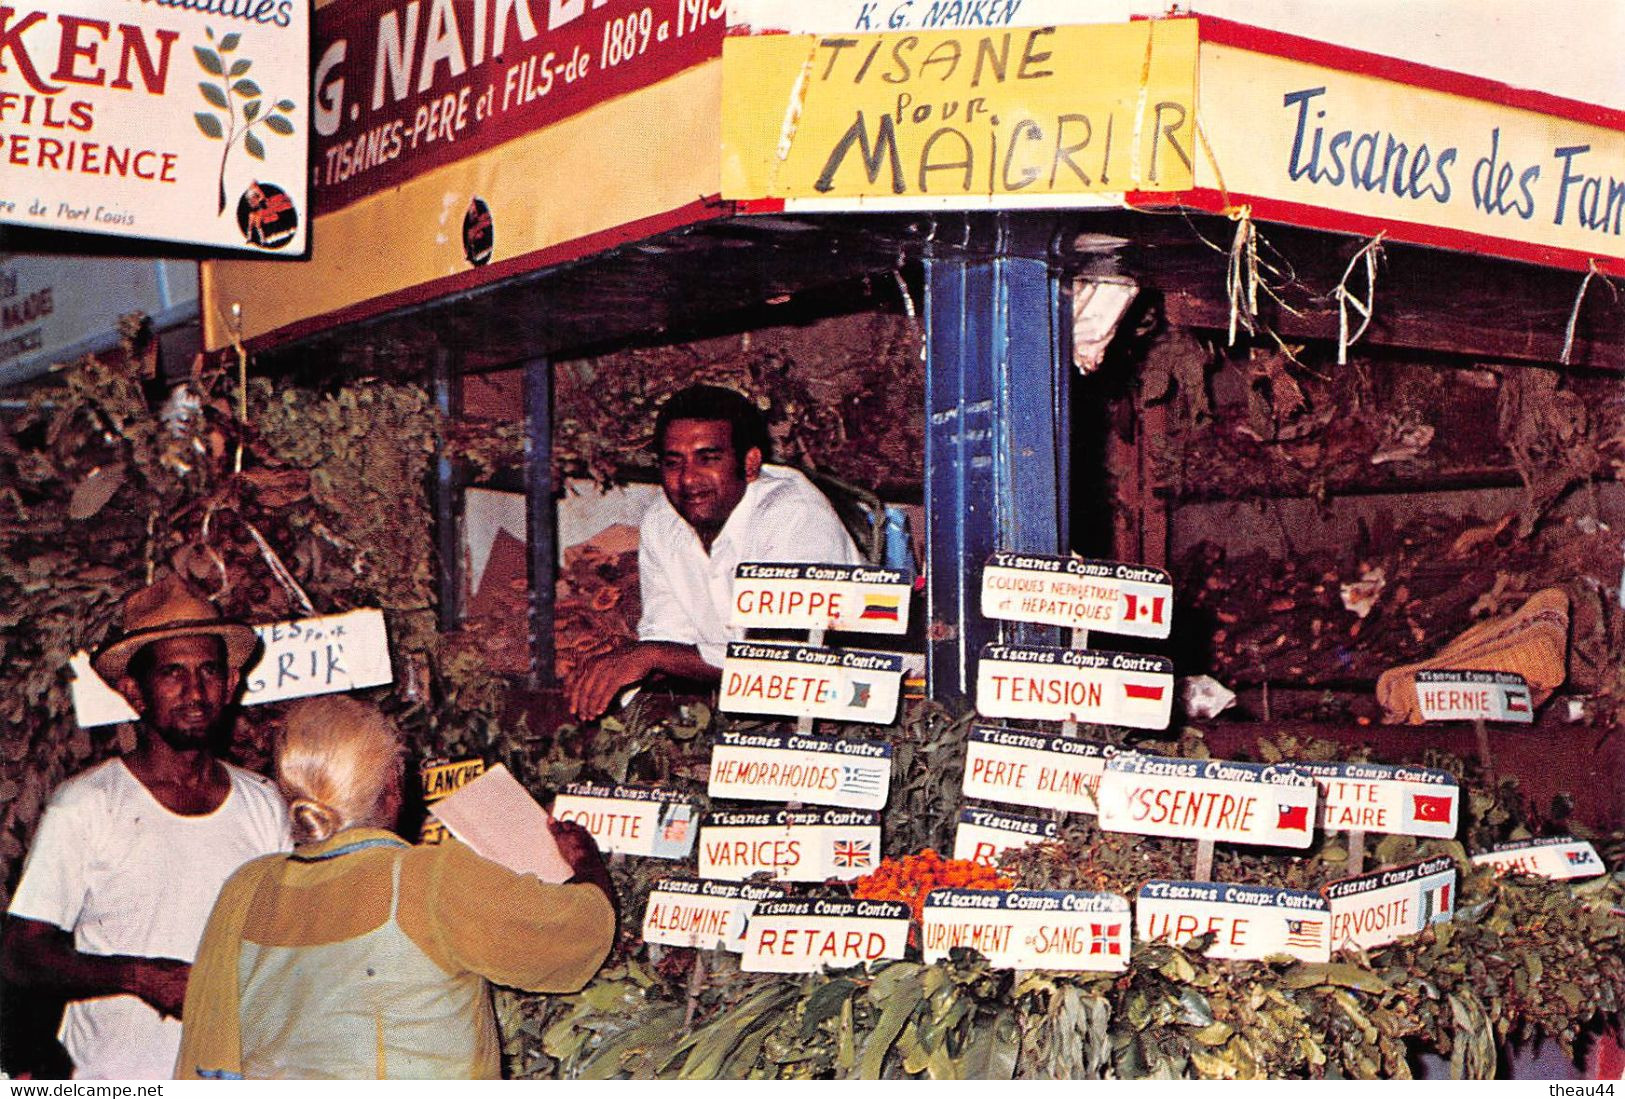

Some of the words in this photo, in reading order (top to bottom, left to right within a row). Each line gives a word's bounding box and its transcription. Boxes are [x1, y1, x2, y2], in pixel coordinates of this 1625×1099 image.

[922, 0, 1024, 28] NAIKEN
[372, 0, 608, 112] NAIKE
[475, 84, 495, 121] et
[600, 7, 652, 70] 1889
[819, 26, 1057, 88] TISANE
[0, 134, 179, 183] ERIENCE
[1284, 87, 1457, 203] Tisanes
[1472, 127, 1540, 220] des
[29, 198, 48, 216] de
[741, 565, 799, 579] Tisanes
[852, 568, 900, 584] Contre
[992, 554, 1060, 571] Tisanes
[1116, 565, 1165, 584] Contre
[737, 590, 842, 619] GRIPPE
[1021, 598, 1112, 620] HEPATIQUES
[731, 645, 789, 660] Tisanes
[842, 653, 892, 670] Contre
[990, 648, 1055, 664] Tisanes
[1112, 656, 1162, 672] Contre
[727, 673, 831, 704] DIABETE
[991, 676, 1102, 707] TENSION
[1425, 690, 1490, 711] HERNIE
[723, 732, 781, 748] Tisanes
[835, 740, 884, 756] Contre
[979, 729, 1046, 750] Tisanes
[972, 758, 1028, 788] PERTE
[1109, 755, 1197, 776] Tisanes
[1260, 766, 1314, 787] Contre
[1394, 769, 1444, 784] Contre
[712, 812, 770, 825] Tisanes
[823, 811, 873, 825] Contre
[972, 812, 1038, 834] Tisanes
[705, 841, 801, 866] VARICES
[657, 879, 698, 893] Tisanes
[1147, 884, 1217, 900] Tisanes
[1276, 893, 1324, 910] Contre
[1327, 877, 1377, 898] Tisanes
[759, 902, 809, 916] Tisanes
[857, 902, 902, 918] Contre
[930, 891, 1000, 908] Tisanes
[647, 903, 731, 936] ALBUMINE
[1331, 898, 1409, 941] ERVOSITE
[758, 929, 887, 960] RETARD
[1035, 926, 1085, 954] SANG
